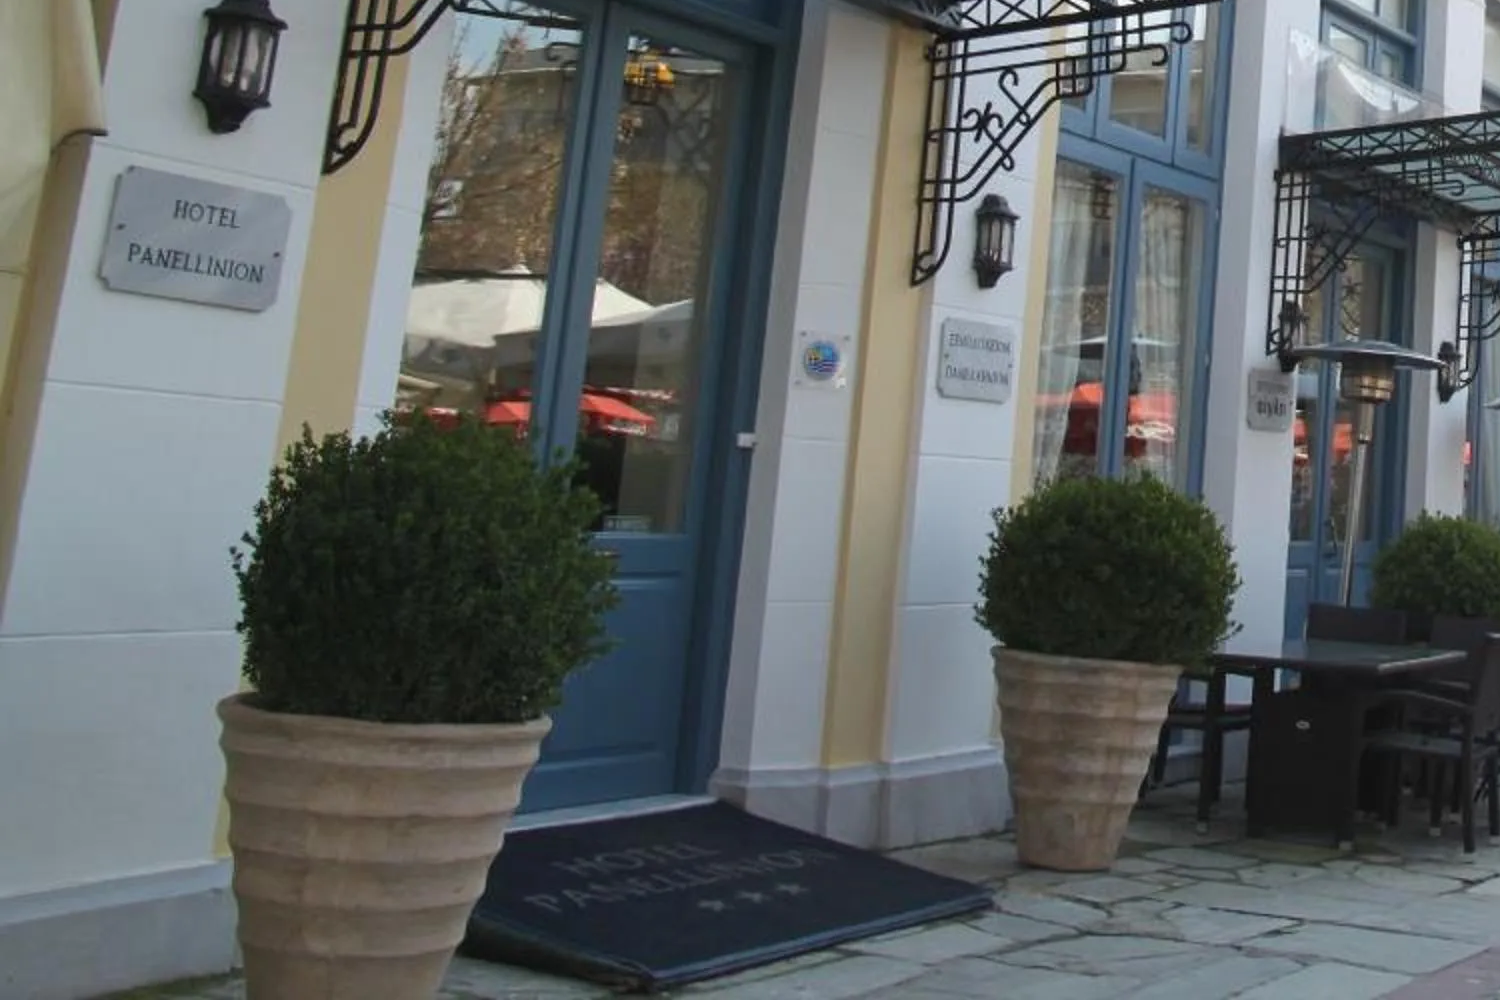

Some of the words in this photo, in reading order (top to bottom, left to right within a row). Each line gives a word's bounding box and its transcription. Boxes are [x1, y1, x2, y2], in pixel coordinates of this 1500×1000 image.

[173, 199, 241, 229] HOTEL
[127, 242, 265, 283] PANELLINION
[549, 841, 723, 878] HOTEL
